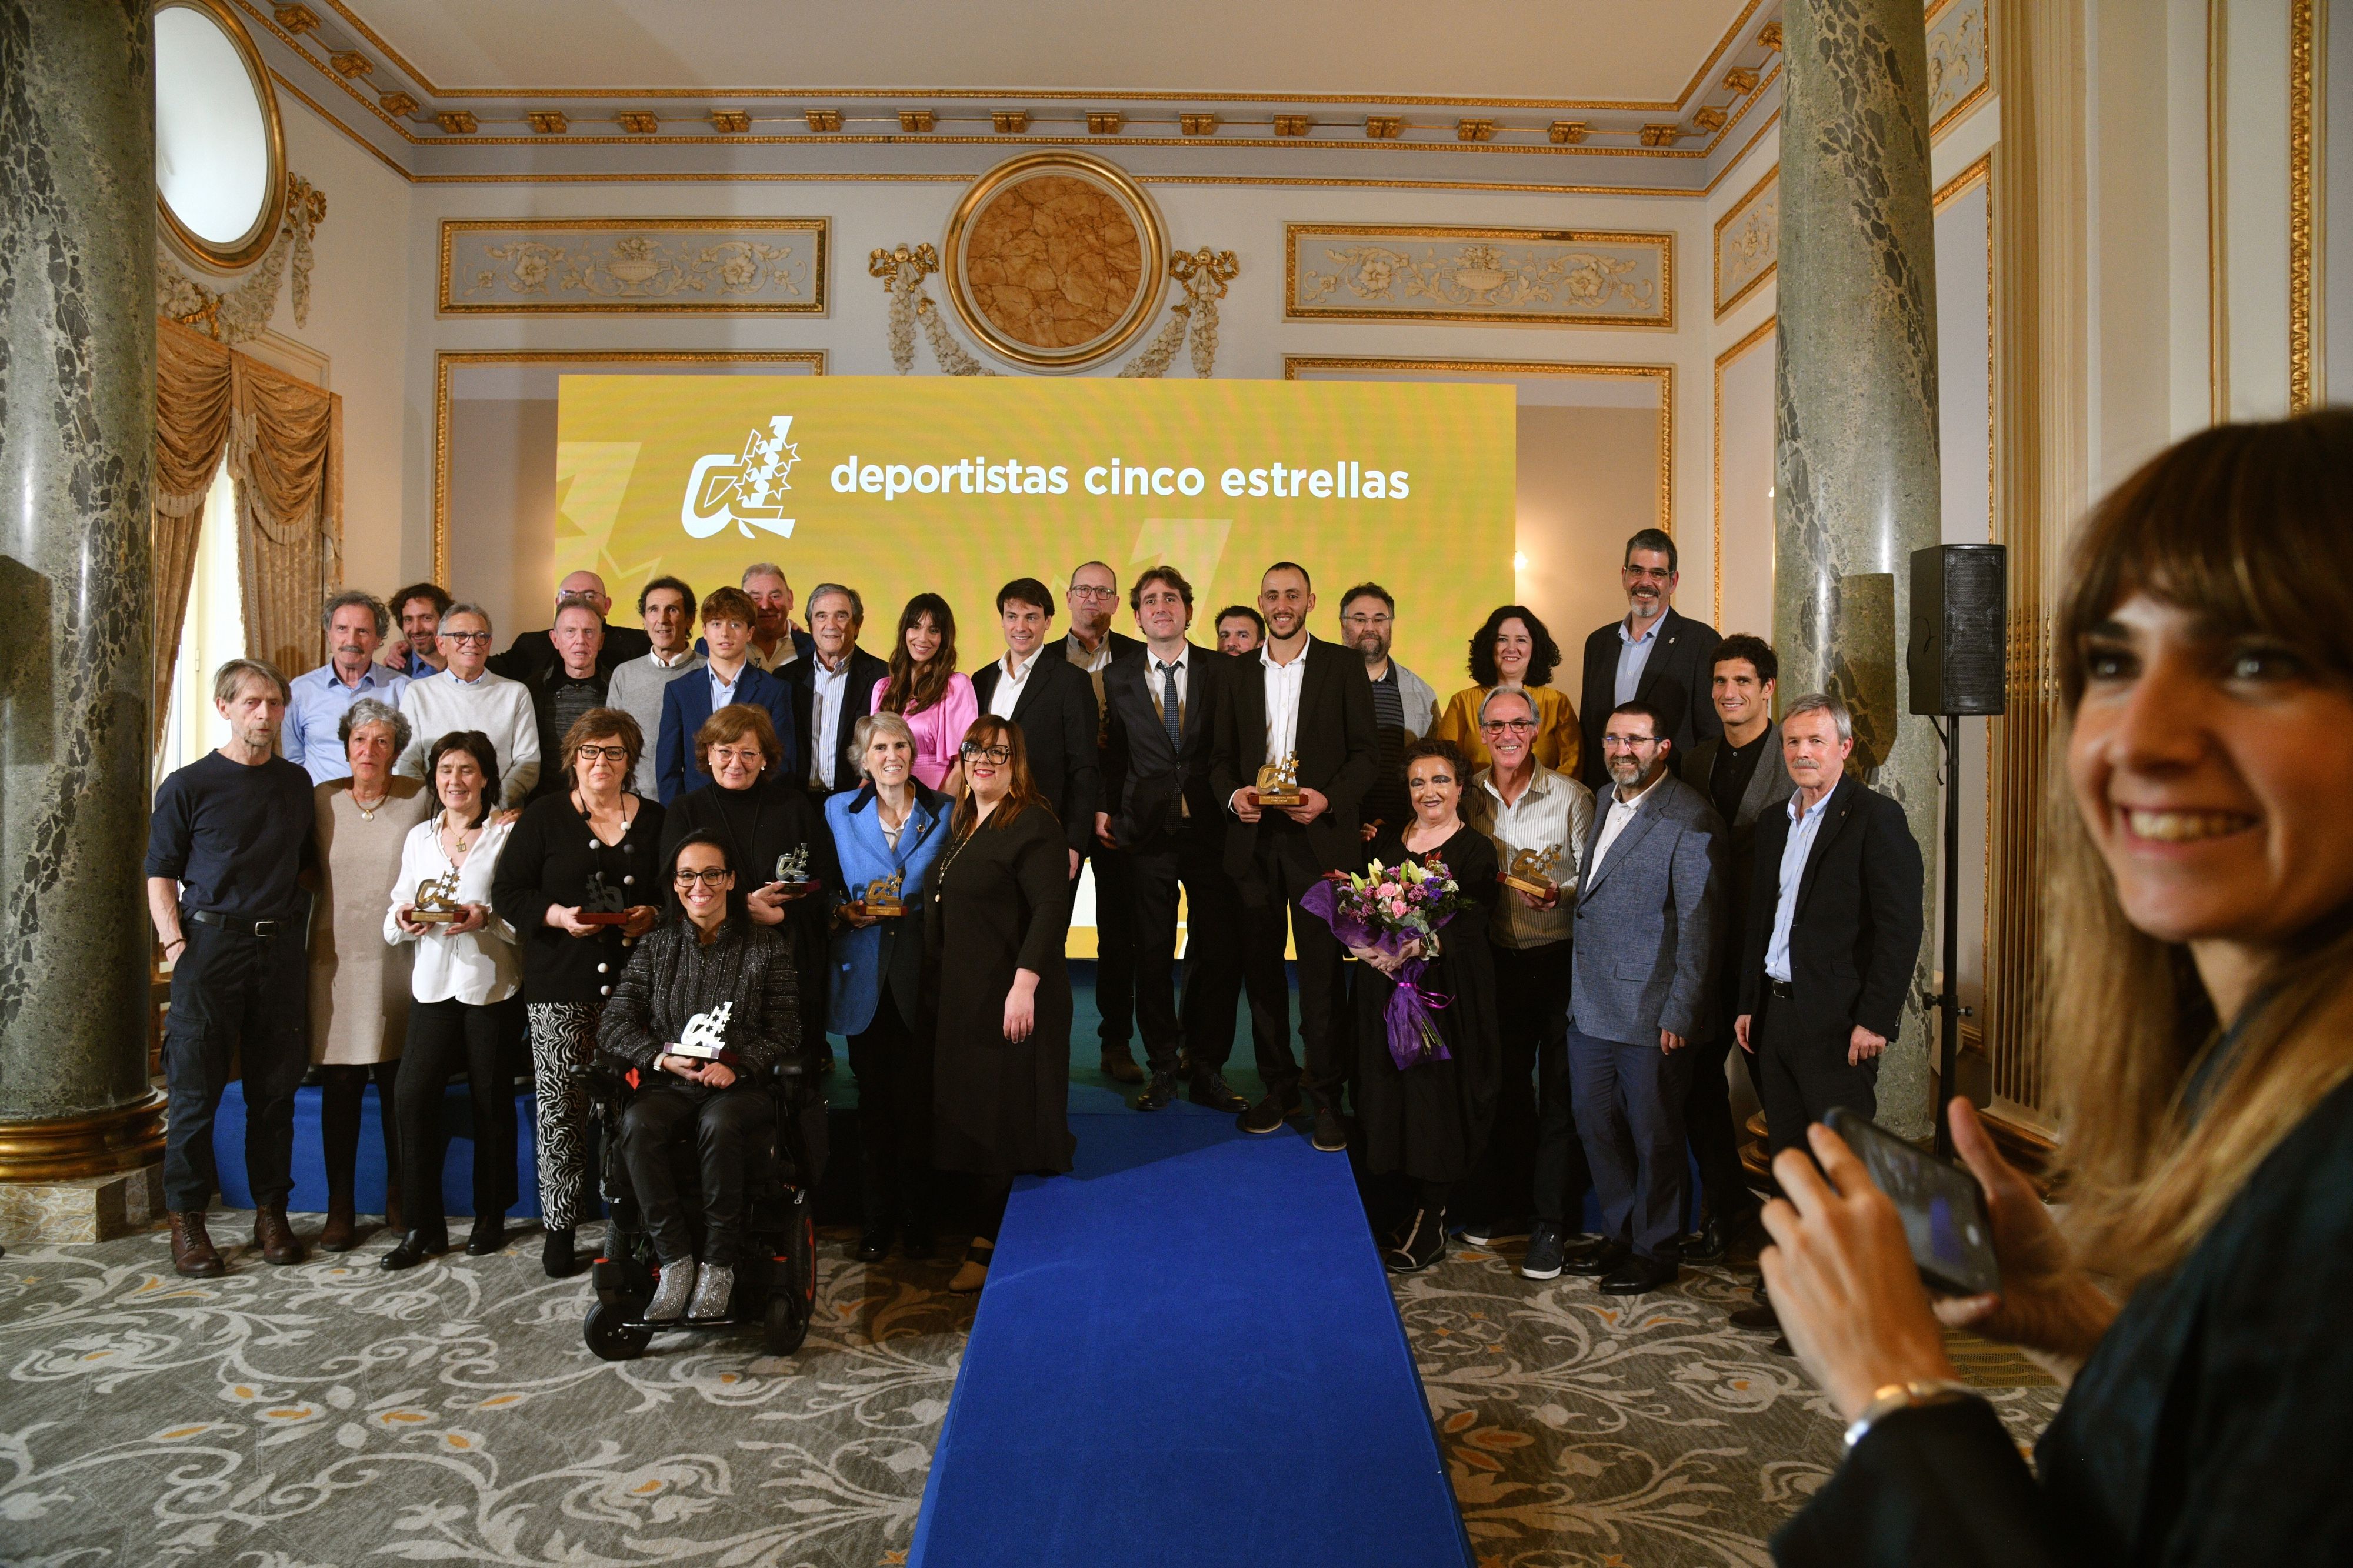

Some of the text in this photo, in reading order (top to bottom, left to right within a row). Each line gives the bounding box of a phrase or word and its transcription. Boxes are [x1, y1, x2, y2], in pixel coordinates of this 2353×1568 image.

[831, 455, 1410, 501] deportistas cinco estrellas
